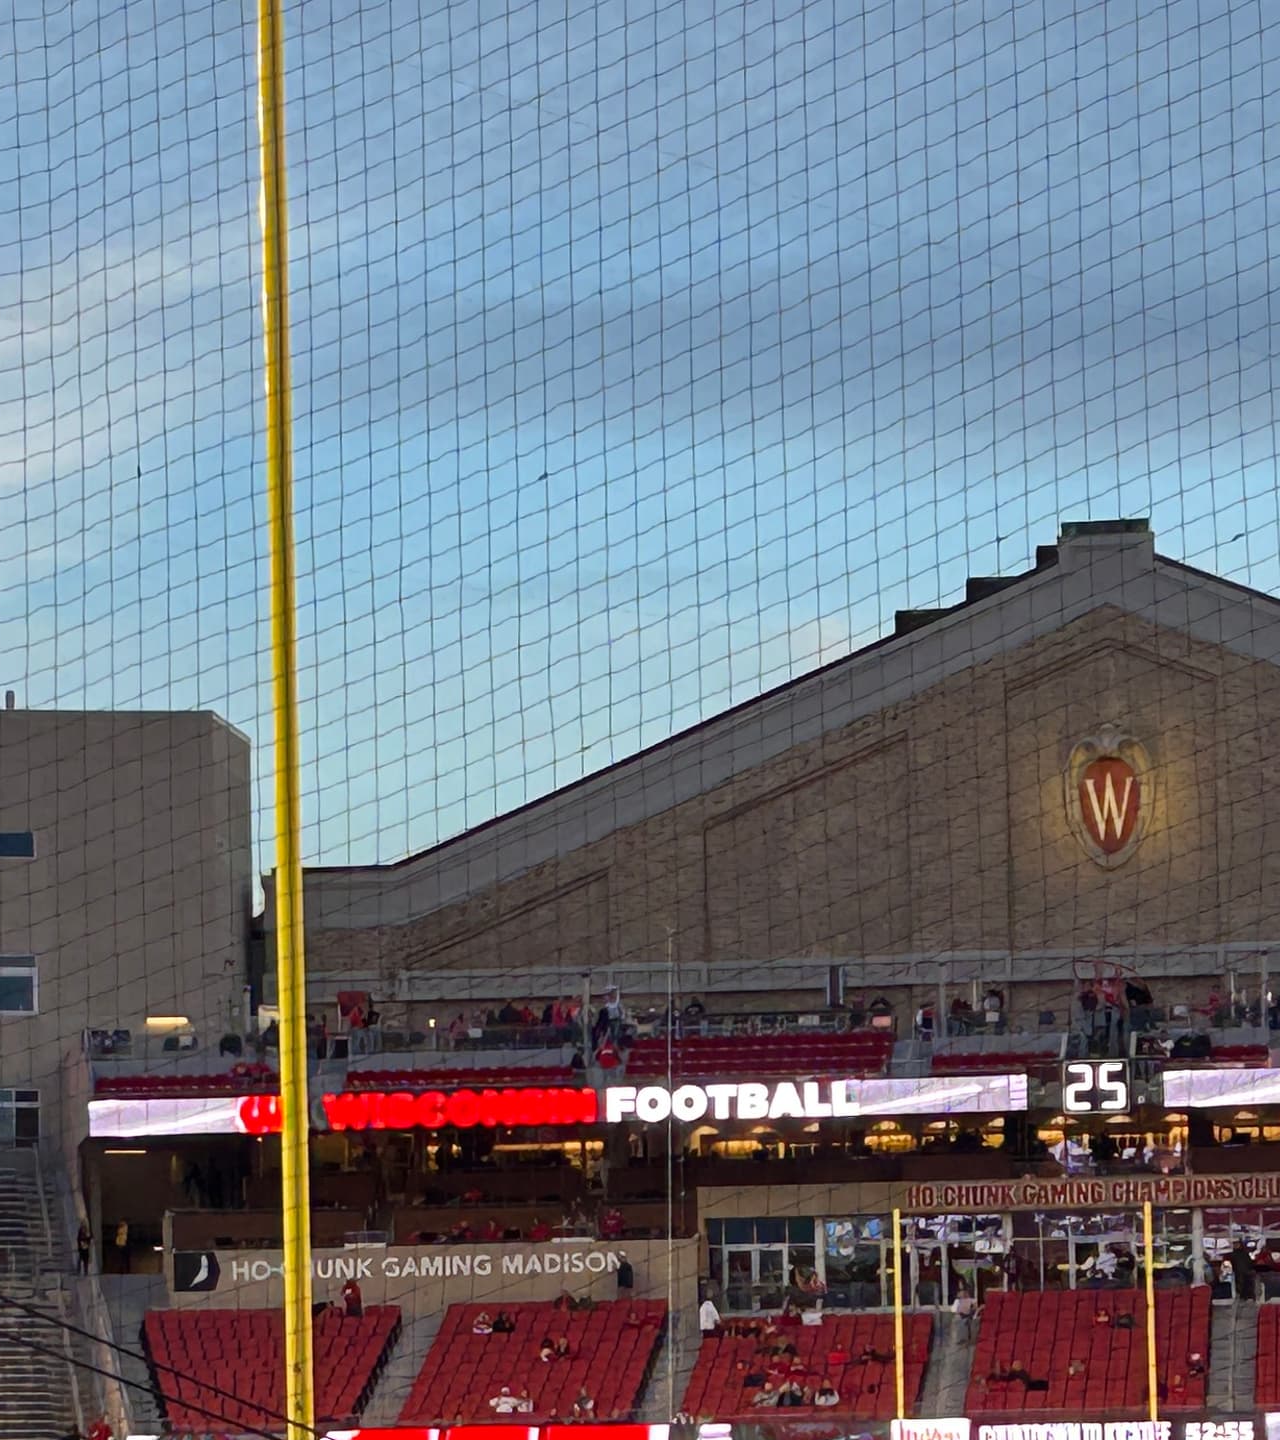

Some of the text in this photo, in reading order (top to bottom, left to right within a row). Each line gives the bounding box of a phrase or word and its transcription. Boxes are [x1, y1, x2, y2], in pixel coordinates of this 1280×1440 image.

[1085, 772, 1134, 840] W
[606, 1081, 860, 1123] FOOTBALL
[1066, 1064, 1124, 1110] 25
[382, 1254, 492, 1279] GAMING
[502, 1251, 625, 1275] MADISON
